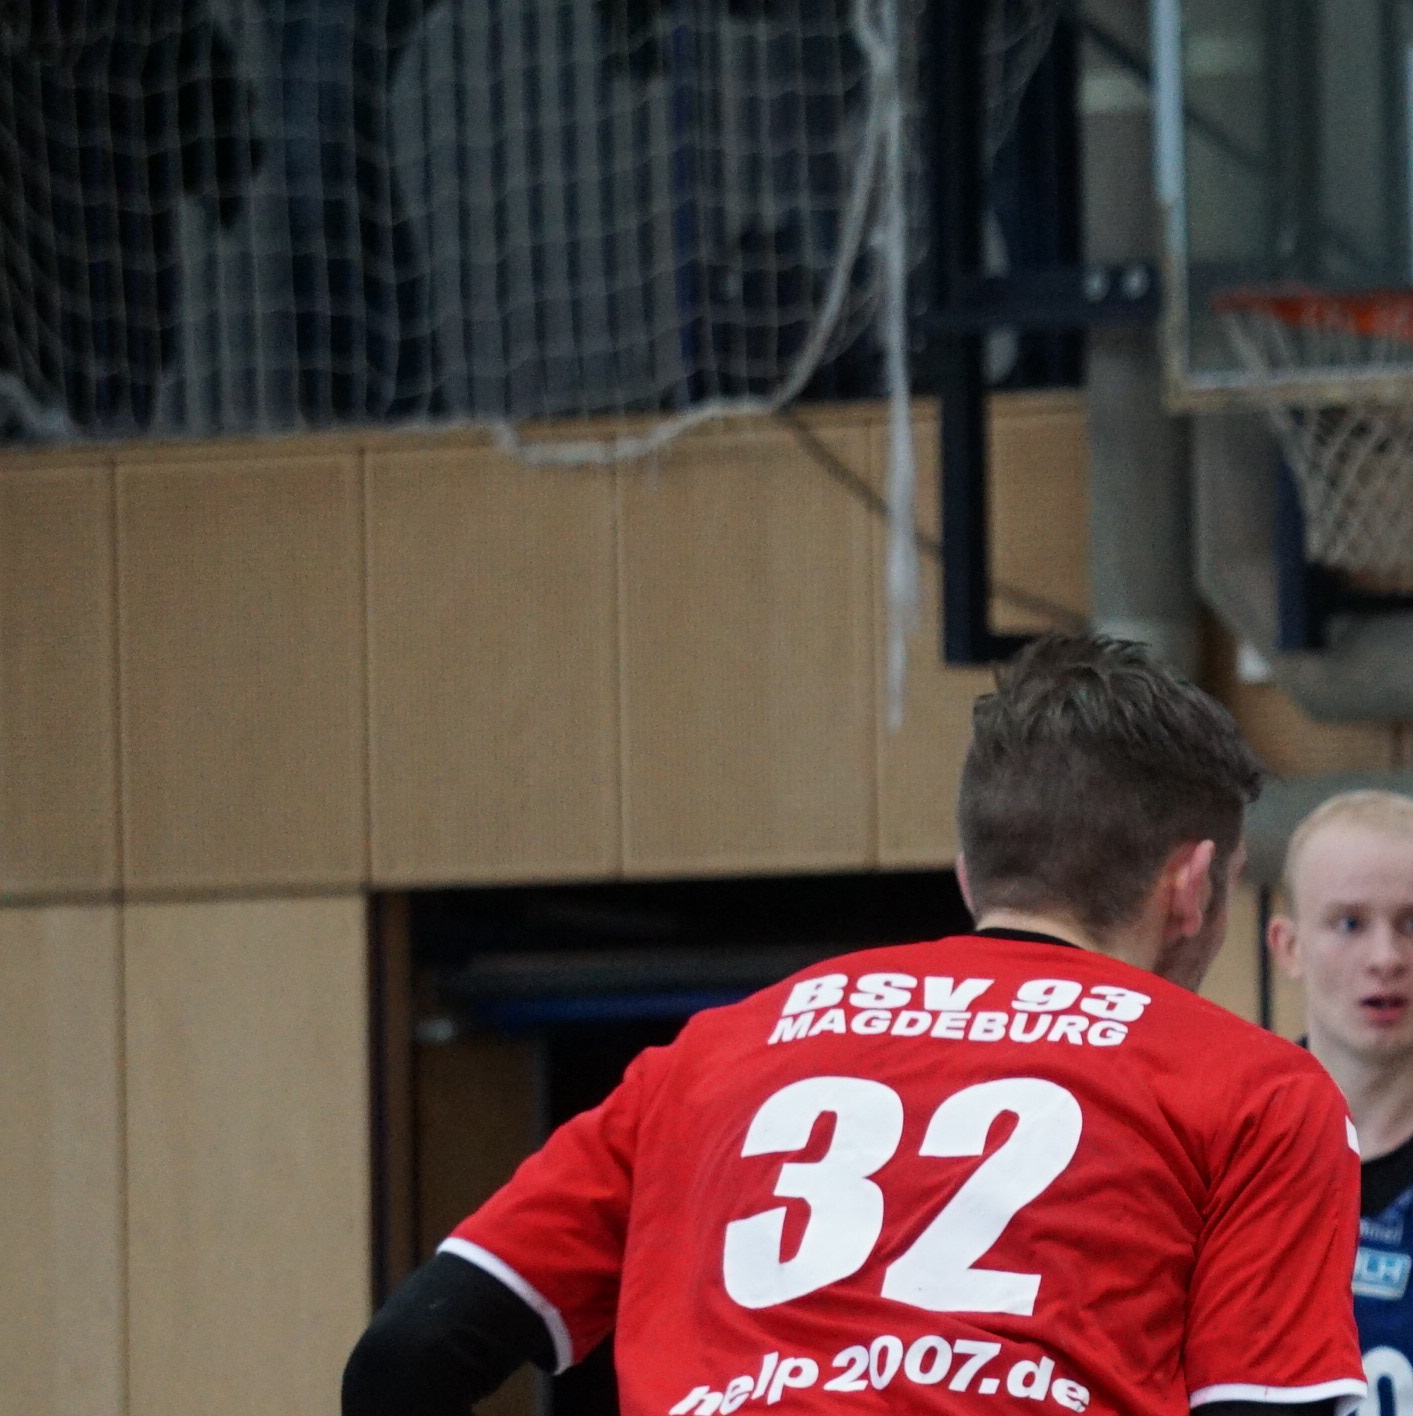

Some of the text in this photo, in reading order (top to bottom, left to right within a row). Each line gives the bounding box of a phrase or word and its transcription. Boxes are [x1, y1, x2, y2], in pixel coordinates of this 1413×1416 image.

[784, 972, 1152, 1023] BSV 93
[767, 1007, 1129, 1047] MAGDEBURG
[722, 1076, 1084, 1317] 32
